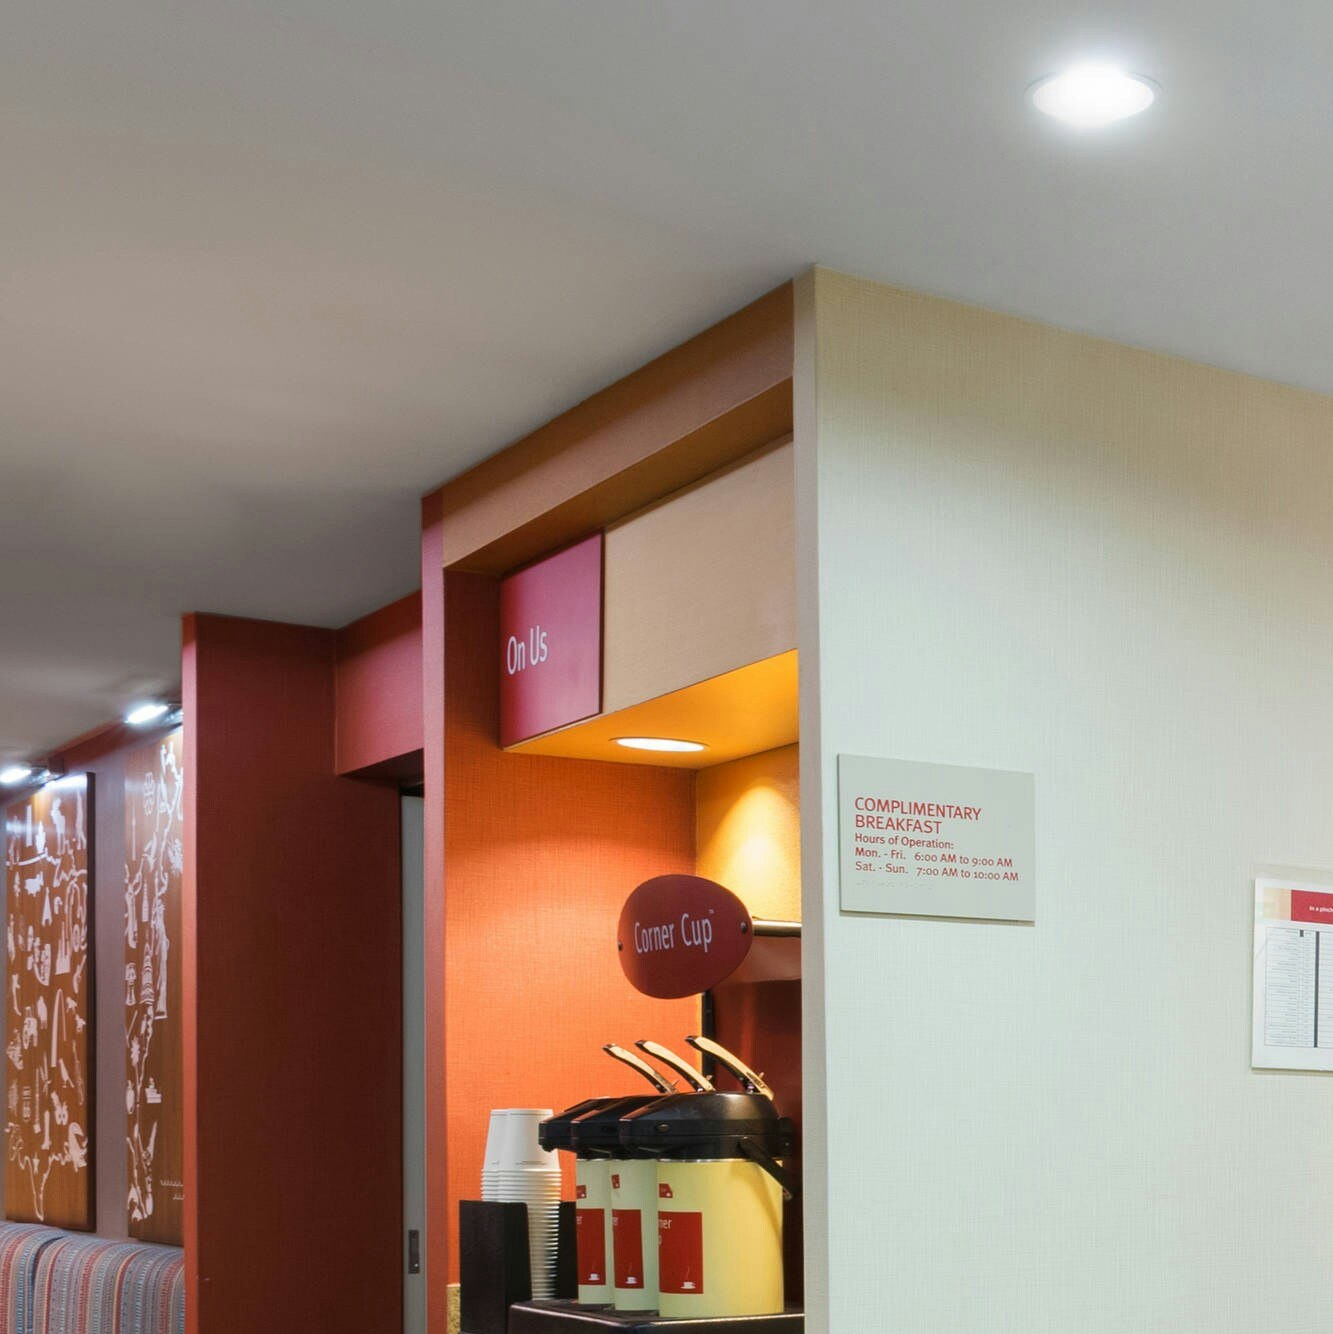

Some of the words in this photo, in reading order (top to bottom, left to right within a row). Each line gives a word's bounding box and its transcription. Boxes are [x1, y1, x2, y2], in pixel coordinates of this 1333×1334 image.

[506, 635, 526, 675] On
[529, 625, 548, 666] Us
[855, 797, 982, 821] COMPLIMENTARY
[855, 814, 943, 834] BREAKFAST
[855, 833, 886, 845] Hours
[888, 834, 899, 846] of
[901, 836, 955, 850] Operation:
[855, 847, 882, 859] Mon.
[890, 850, 906, 861] Fri.
[914, 852, 938, 863] 6:00
[940, 853, 957, 864] AM
[959, 855, 970, 865] to
[971, 857, 995, 868] 9:00
[996, 857, 1013, 868] AM
[855, 861, 876, 872] Sat.
[885, 863, 909, 874] Sun.
[916, 866, 939, 877] 7:00
[941, 867, 959, 878] AM
[961, 869, 971, 879] to
[974, 871, 1001, 881] 10:00
[1002, 871, 1020, 882] AM
[634, 922, 675, 954] Corner
[681, 912, 713, 953] Cup
